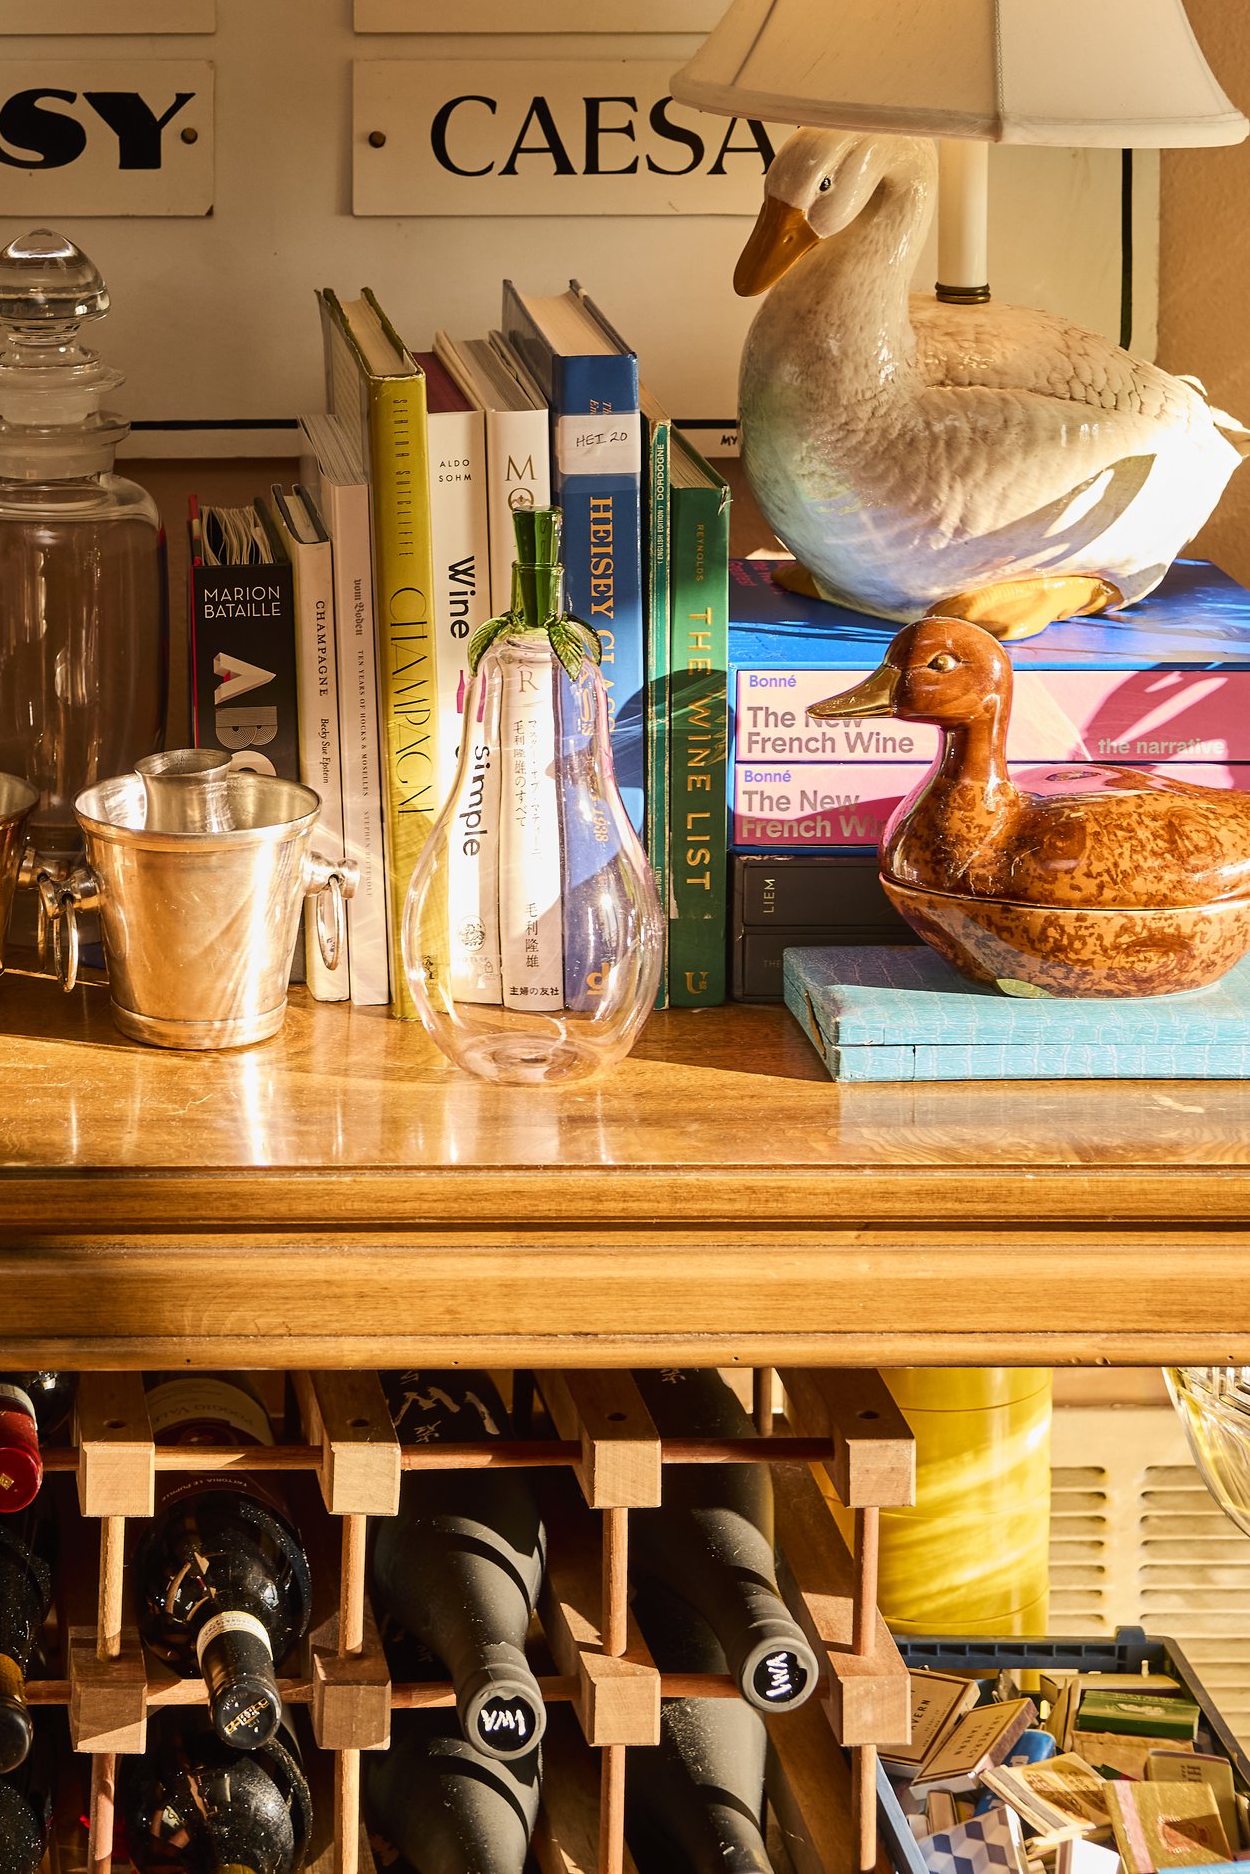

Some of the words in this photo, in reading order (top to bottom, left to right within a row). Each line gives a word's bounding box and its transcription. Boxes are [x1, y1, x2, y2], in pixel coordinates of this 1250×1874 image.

[392, 399, 410, 458] SERENA
[576, 434, 603, 448] HEI
[610, 432, 628, 443] 20
[440, 459, 470, 468] ALDO
[656, 444, 665, 501] DORDOGNE
[439, 474, 472, 483] SOHM
[395, 470, 414, 557] SUTCLIFFE
[590, 497, 615, 620] HEISEY
[696, 524, 704, 581] REYNOLDS
[204, 586, 280, 602] MARION
[448, 555, 476, 639] Wine
[204, 602, 282, 619] BATAILLE
[315, 600, 329, 697] CHAMPAGNE
[688, 606, 712, 675] THE
[358, 669, 366, 695] YEARS
[749, 675, 797, 688] Bonné
[359, 698, 366, 710] OF
[747, 706, 796, 728] The
[319, 718, 329, 740] Becky
[321, 741, 330, 756] Sue
[687, 693, 712, 791] WINE
[747, 731, 836, 754] French
[844, 731, 914, 754] Wine
[1098, 738, 1130, 754] the
[1136, 737, 1225, 754] narrative
[320, 757, 330, 784] Epstein
[744, 770, 792, 783] Bonné
[742, 790, 791, 812] The
[800, 790, 860, 812] New
[741, 815, 831, 838] French
[686, 812, 711, 890] LIST
[763, 879, 775, 913] LIEM
[525, 902, 540, 968] 毛利隆雄
[509, 986, 560, 996] 主婦の友社
[161, 1483, 191, 1502] PUPILLE
[193, 1479, 204, 1487] LE
[206, 1478, 247, 1487] FATTORIA
